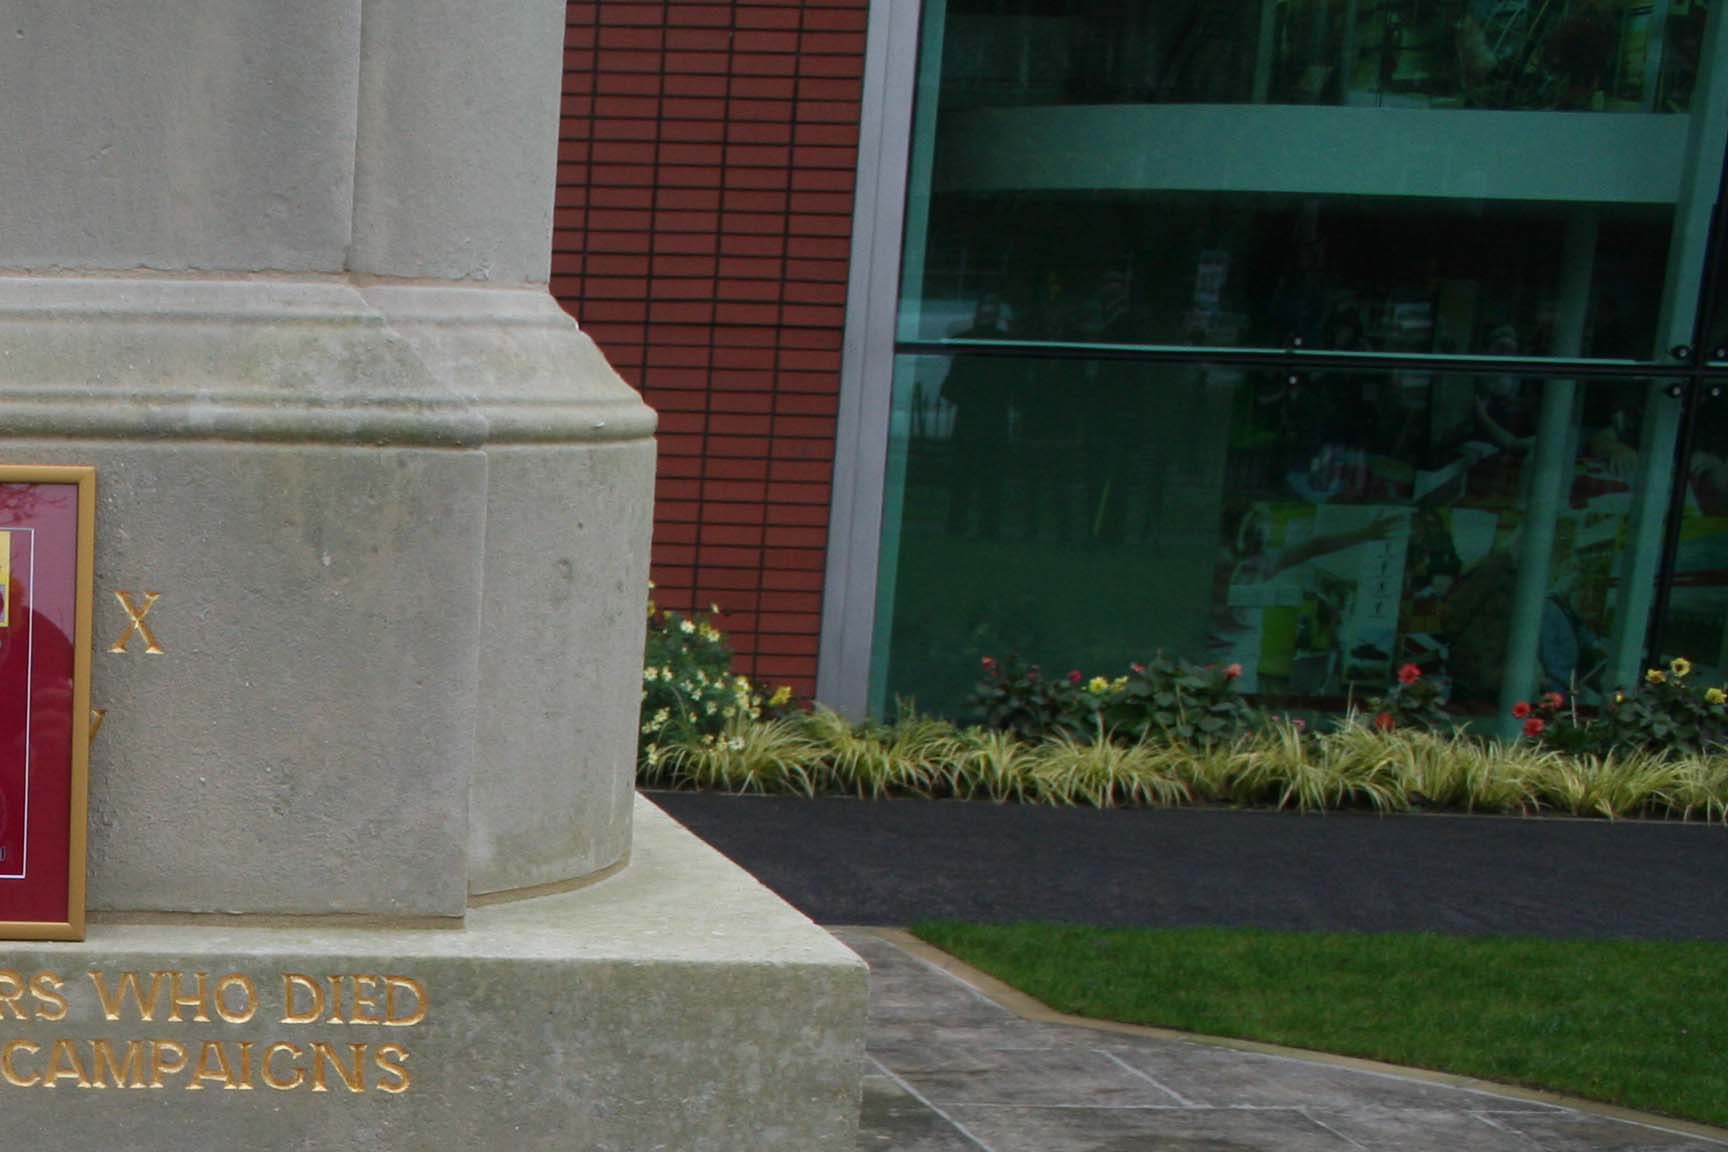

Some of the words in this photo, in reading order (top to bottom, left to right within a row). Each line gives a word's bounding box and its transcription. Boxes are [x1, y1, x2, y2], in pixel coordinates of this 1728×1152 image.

[87, 970, 259, 1025] WHO
[280, 972, 429, 1027] DIED
[0, 1037, 412, 1094] CAMPAIGNS
